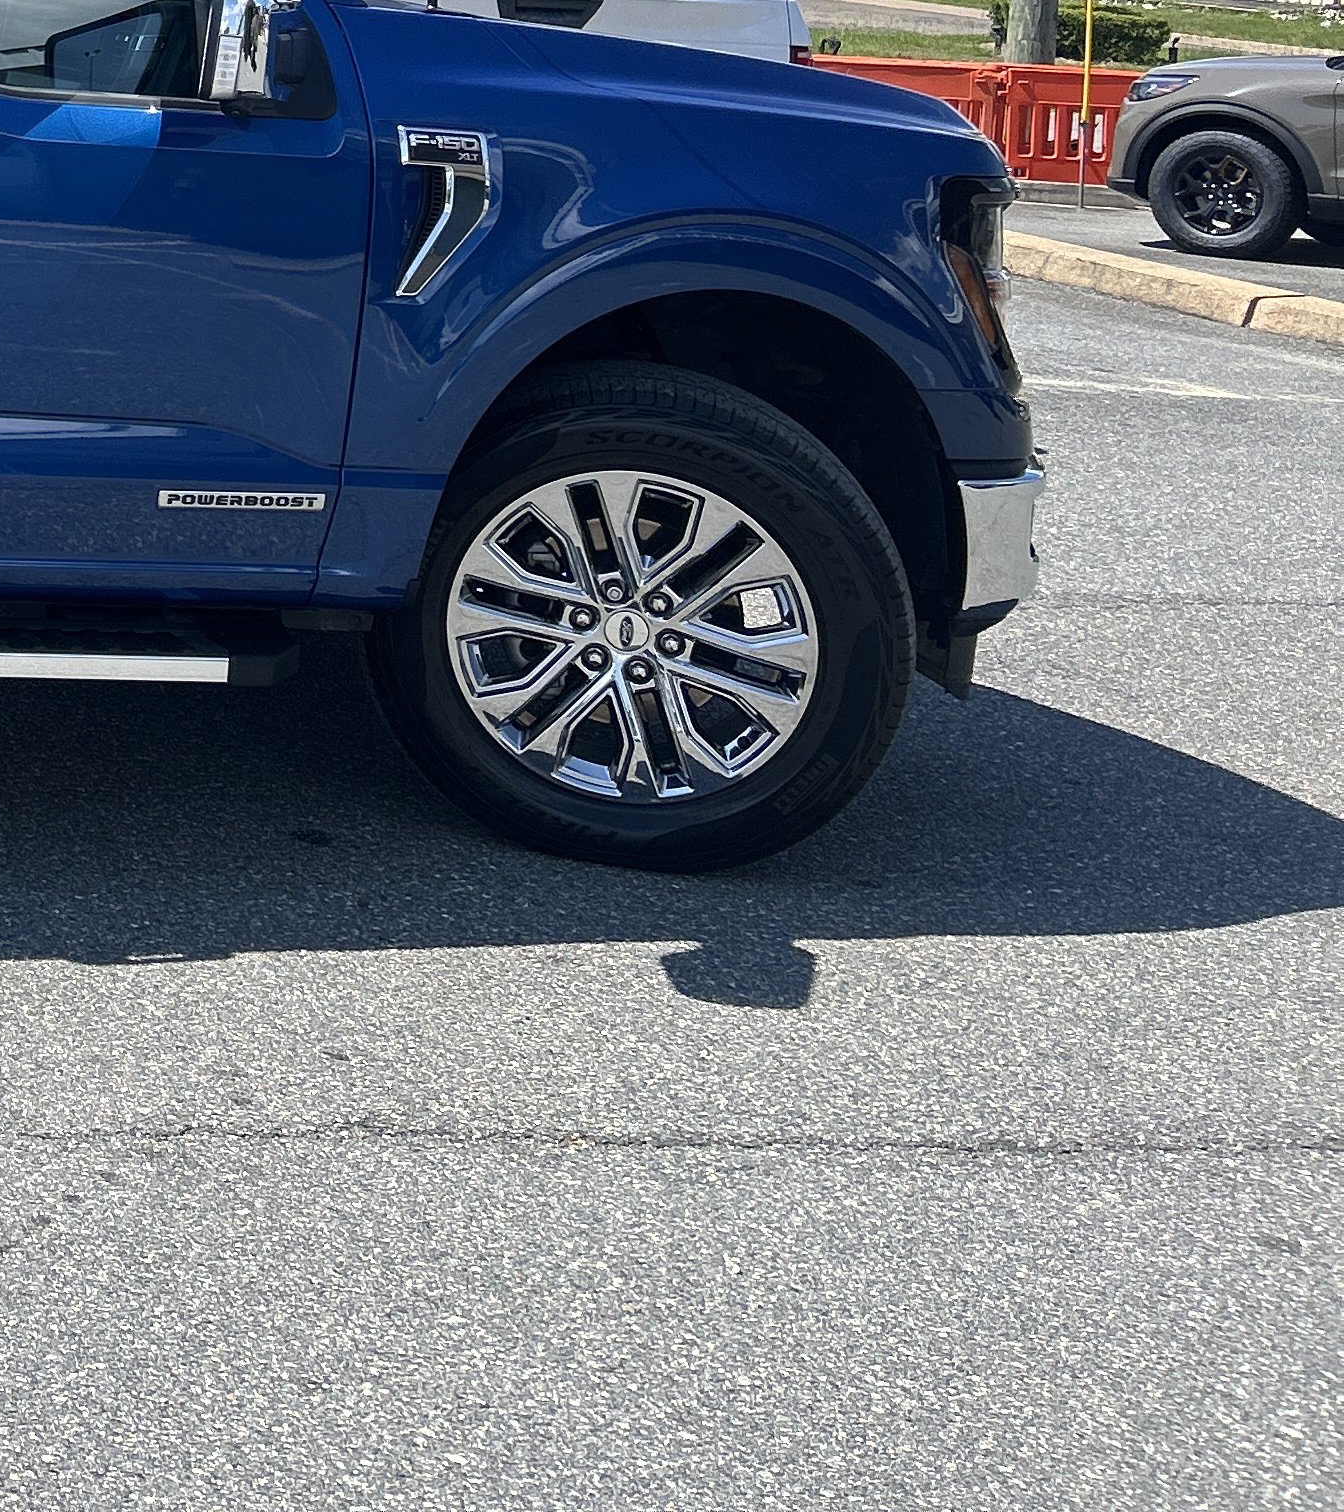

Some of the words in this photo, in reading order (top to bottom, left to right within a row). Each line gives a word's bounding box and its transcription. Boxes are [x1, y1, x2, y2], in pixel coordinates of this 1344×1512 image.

[409, 133, 481, 151] F-150
[458, 152, 480, 162] XLT
[166, 493, 318, 508] POWERBOOST
